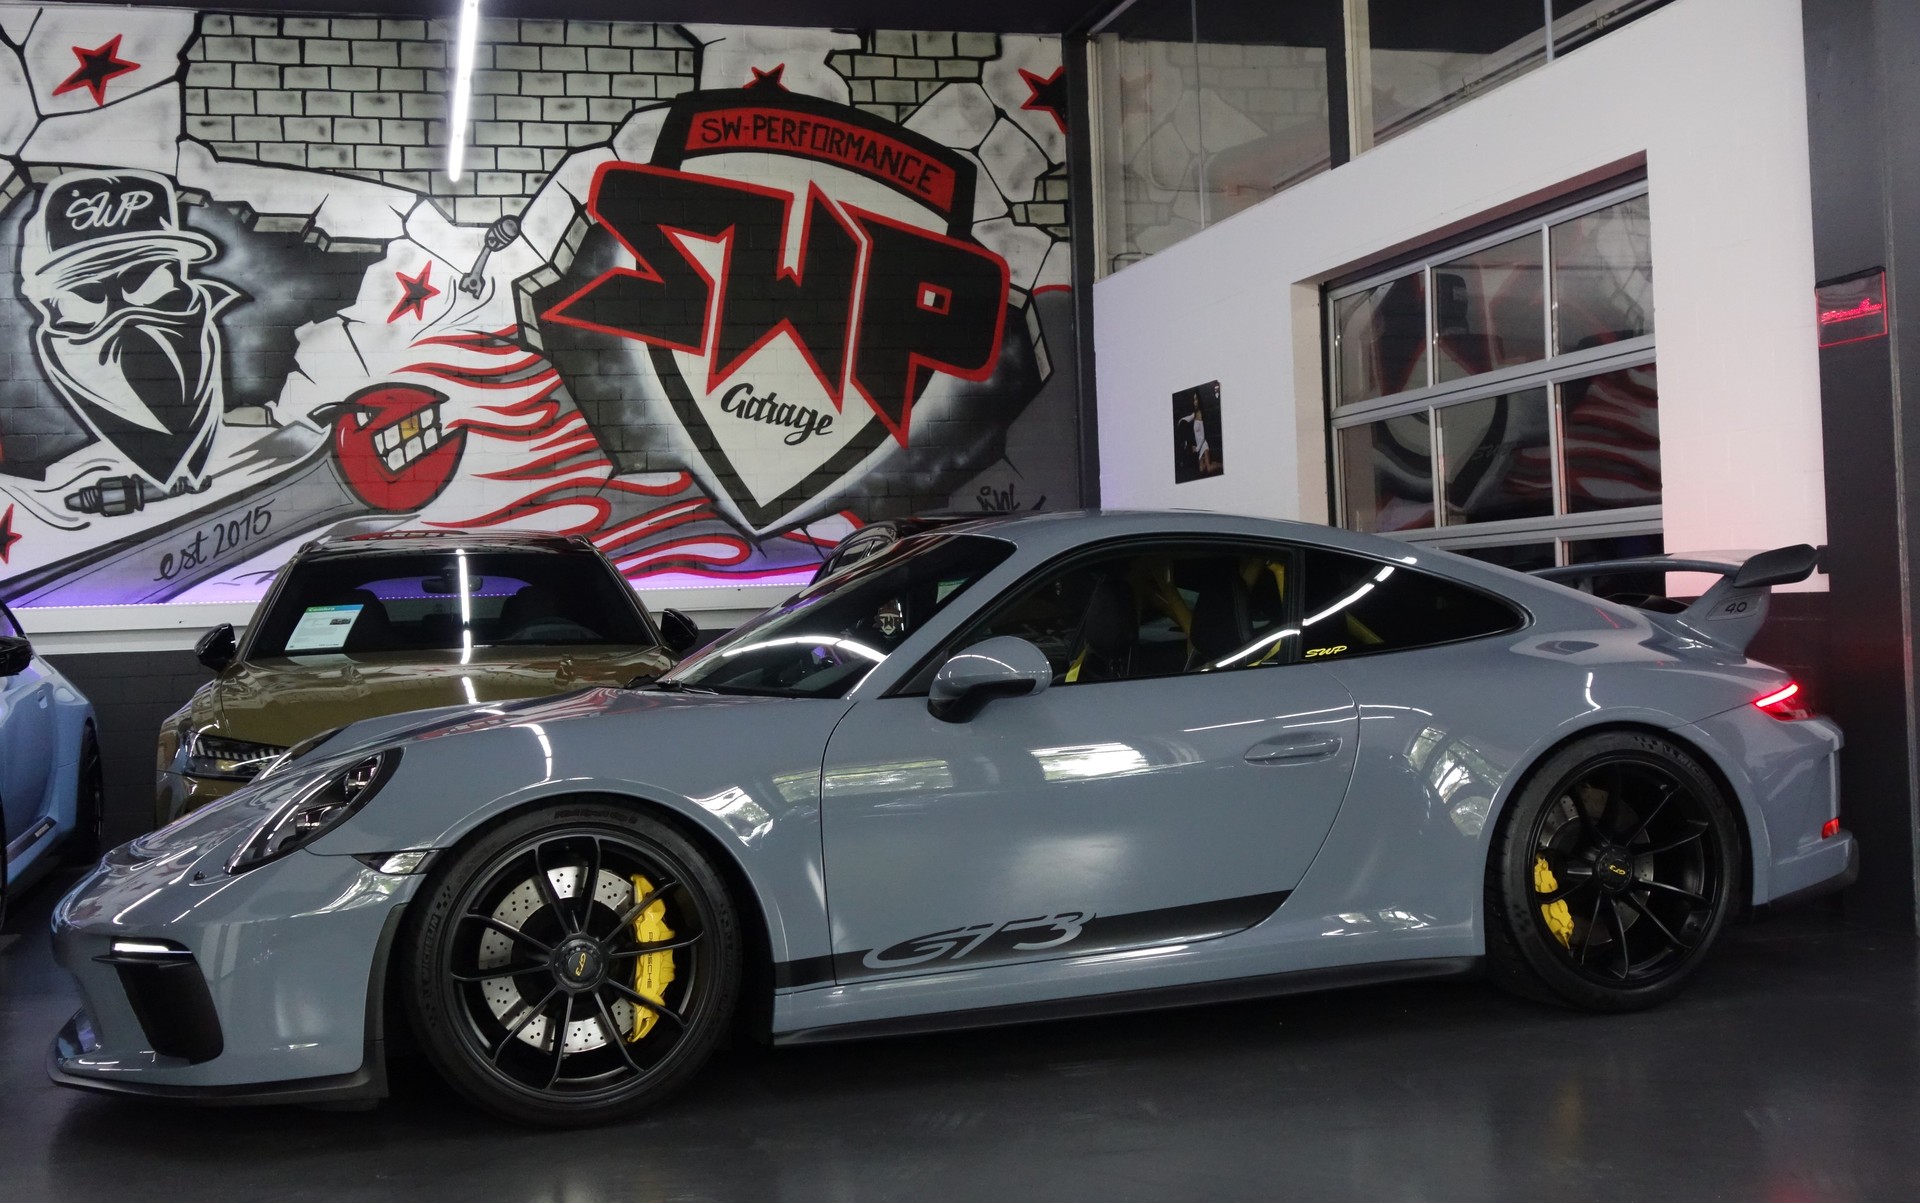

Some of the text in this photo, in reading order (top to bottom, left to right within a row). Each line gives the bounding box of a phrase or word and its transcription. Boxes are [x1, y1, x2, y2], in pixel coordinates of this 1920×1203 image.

[701, 109, 942, 191] SW-PERFORMANCE
[65, 189, 154, 231] SWP
[540, 161, 1010, 450] SWP
[720, 382, 834, 446] Garage
[153, 498, 276, 582] est 2015
[1305, 645, 1348, 658] SWP
[862, 911, 1094, 968] GT3
